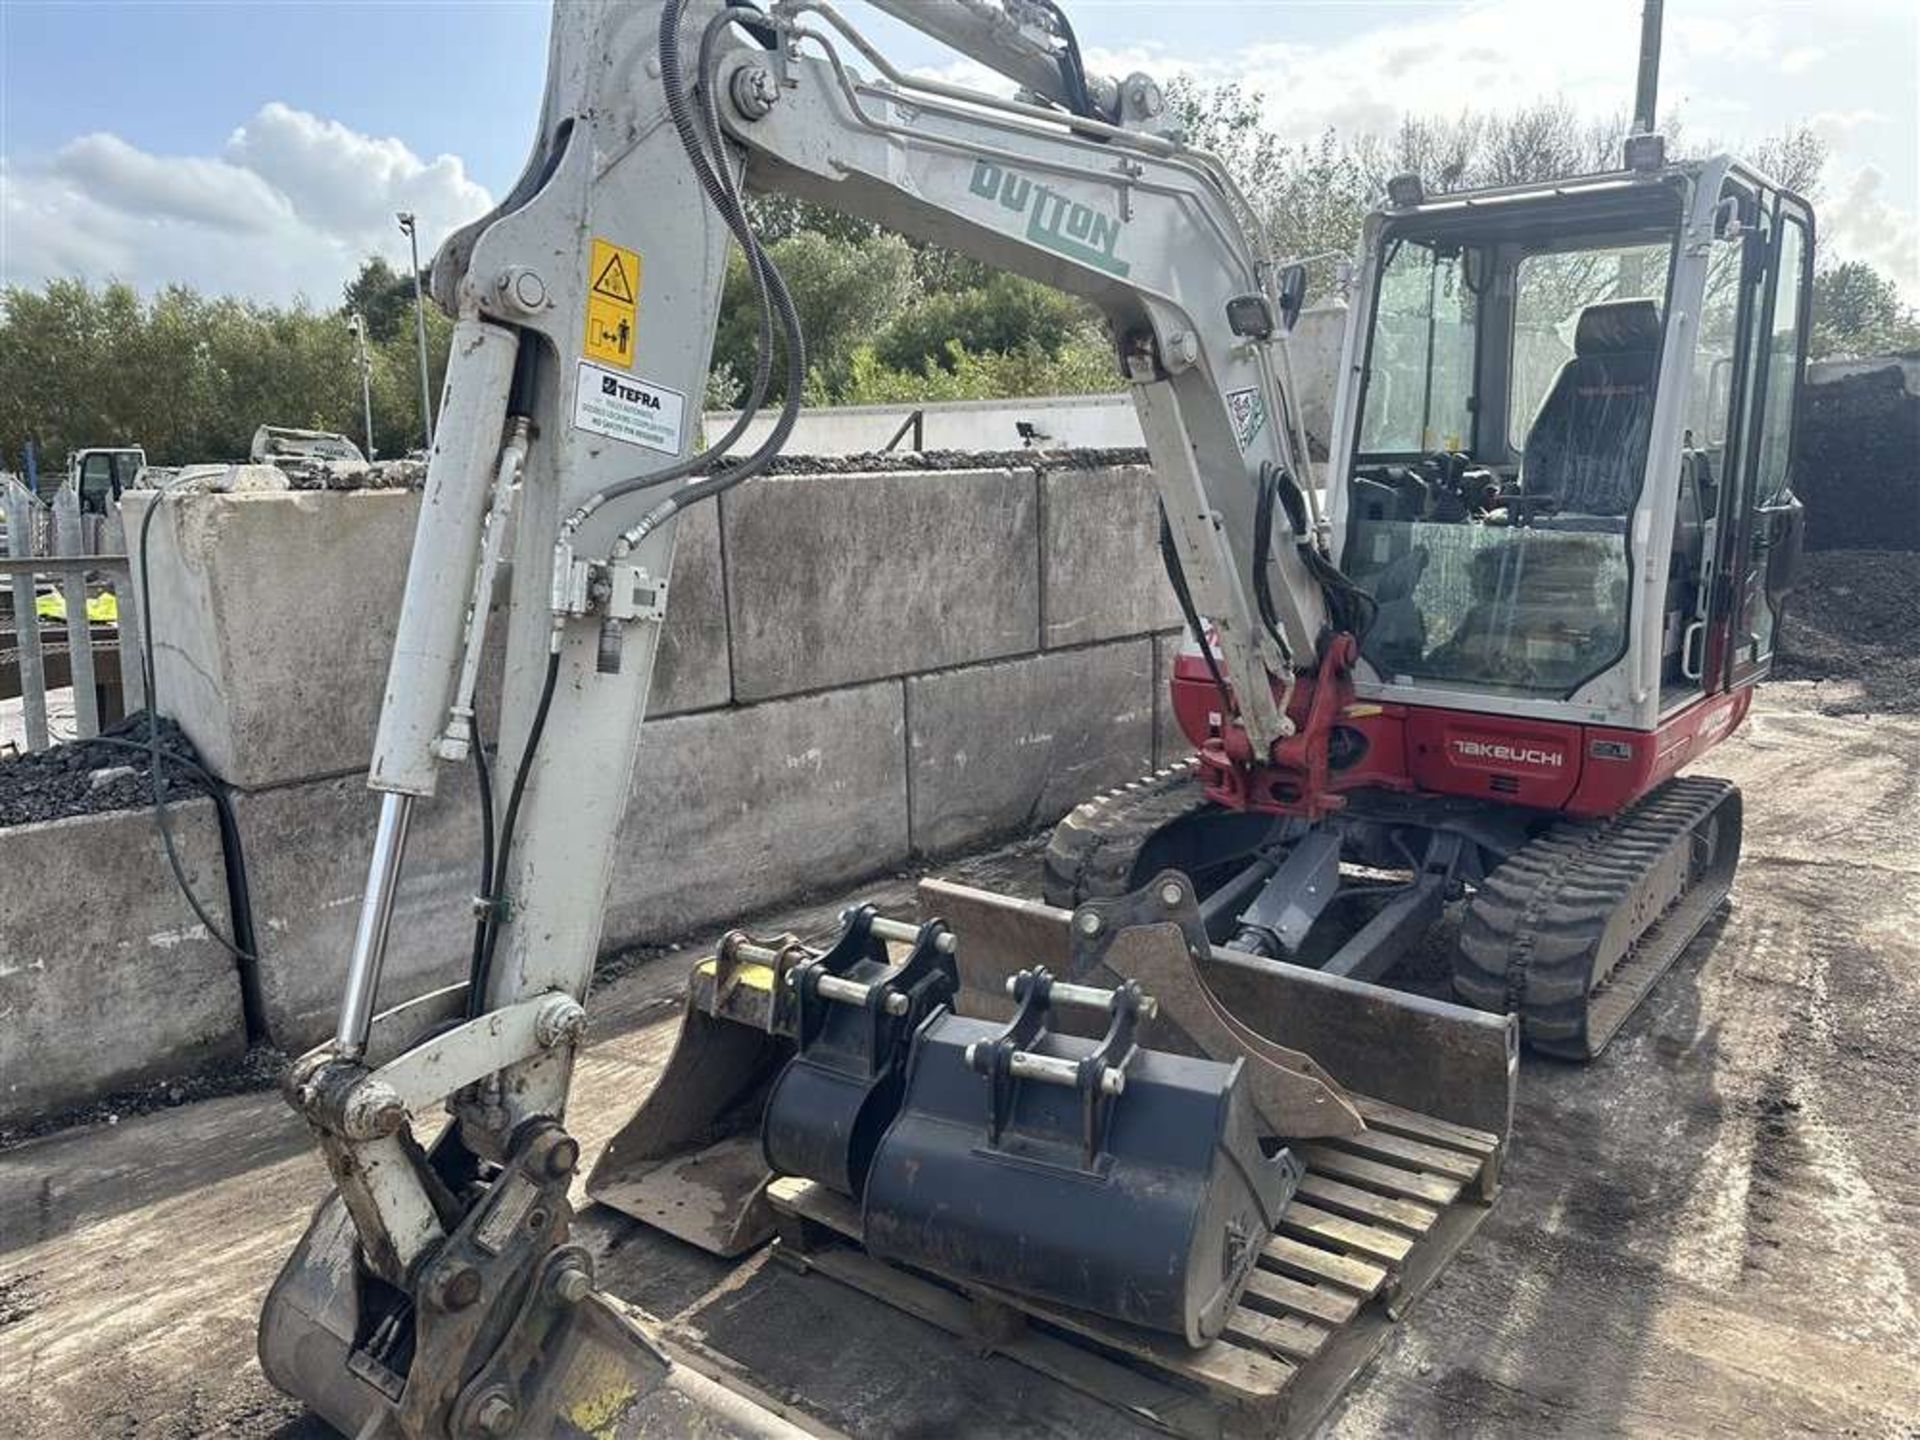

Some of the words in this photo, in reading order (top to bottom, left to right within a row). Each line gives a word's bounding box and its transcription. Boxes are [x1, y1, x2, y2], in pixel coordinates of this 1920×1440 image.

[969, 161, 1130, 277] DUTTON
[618, 385, 661, 410] TEFRA
[1454, 740, 1563, 767] TAKEUCHI
